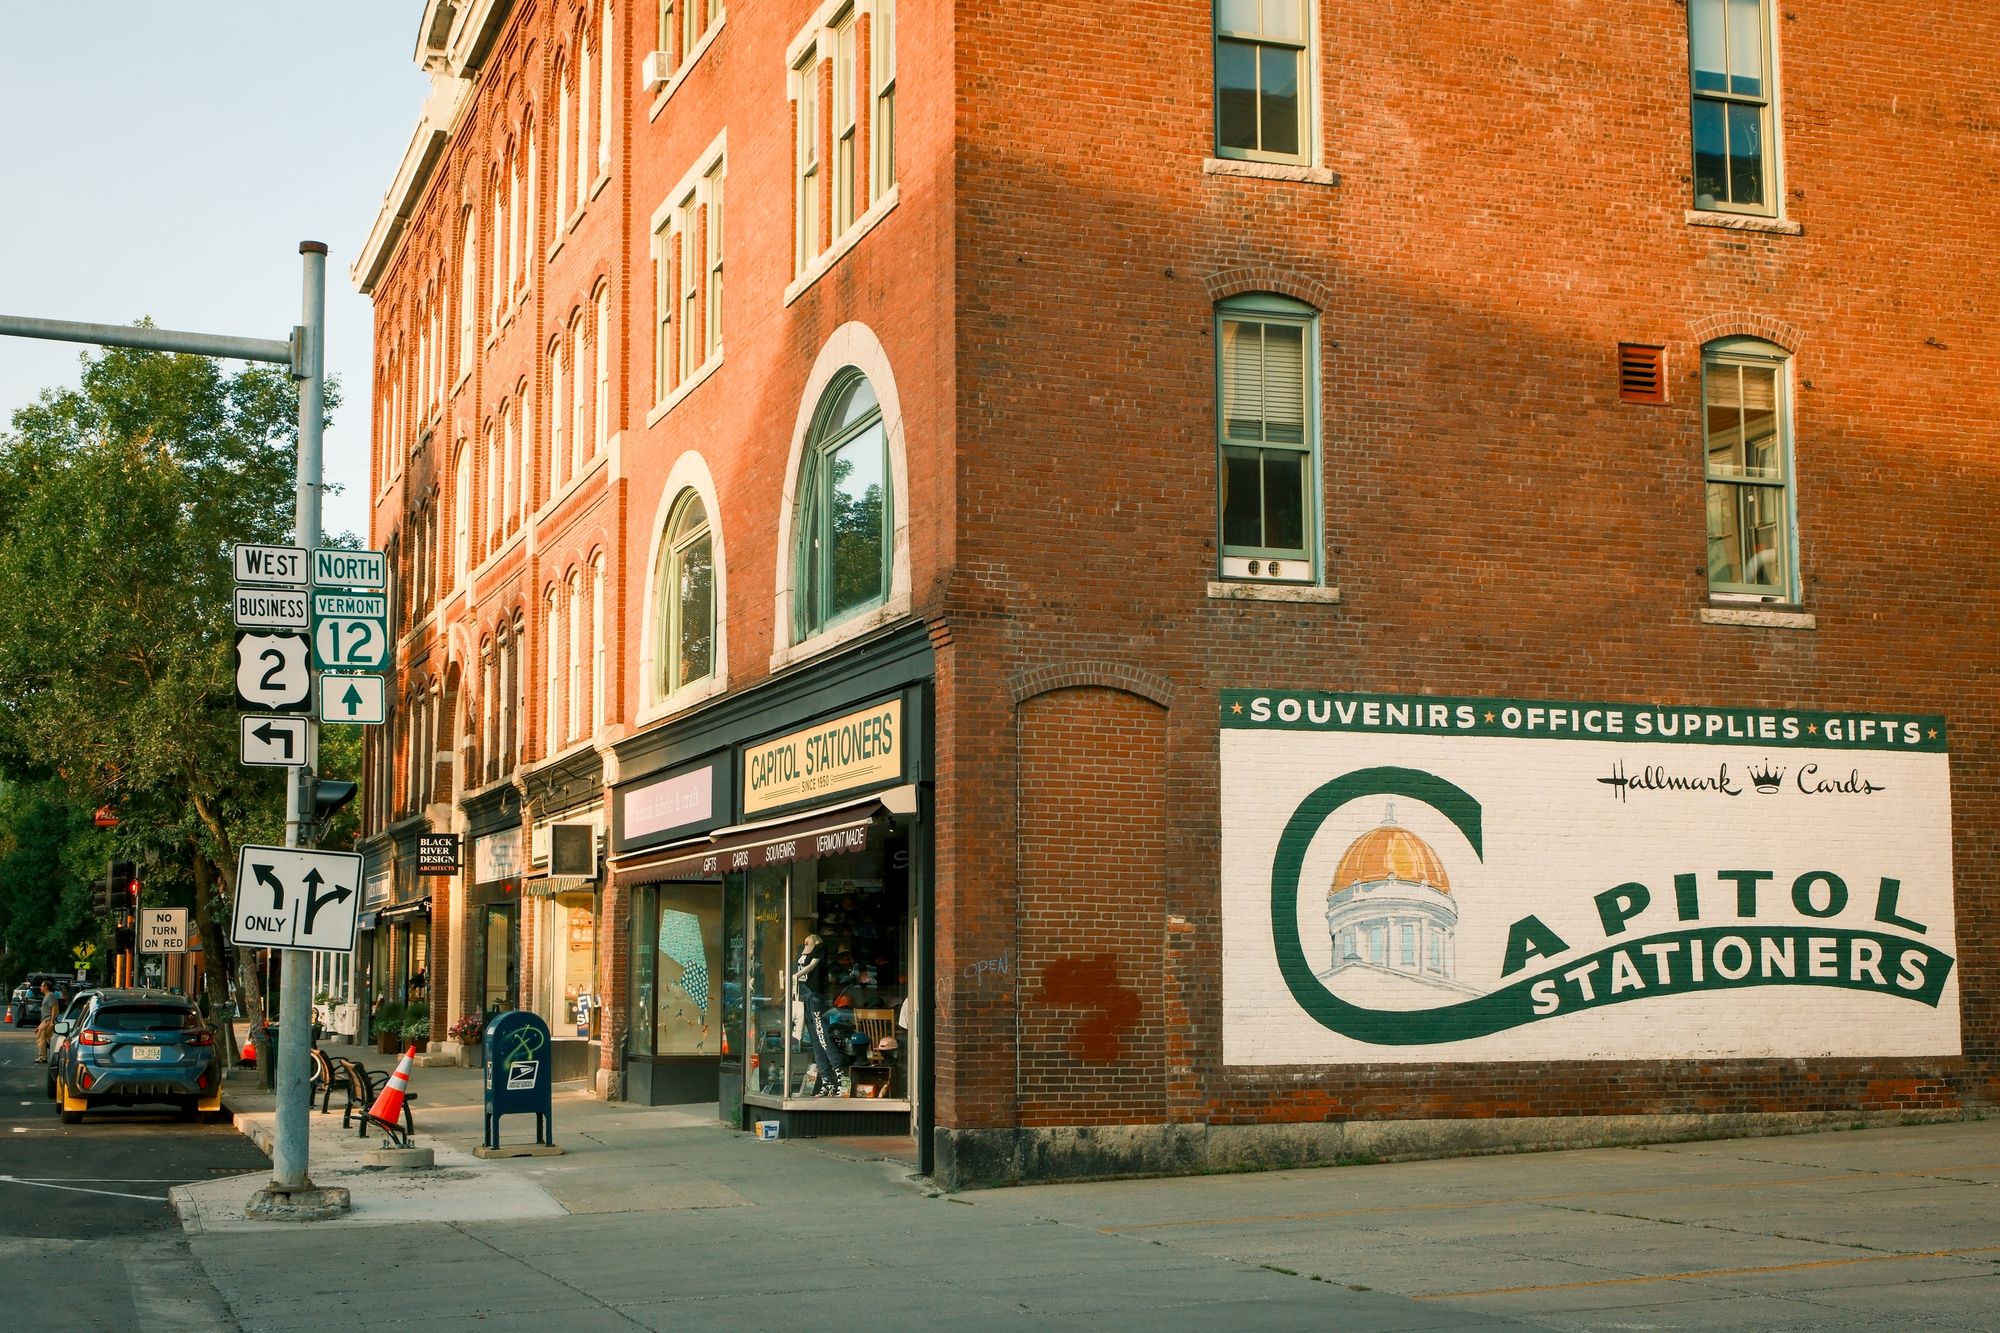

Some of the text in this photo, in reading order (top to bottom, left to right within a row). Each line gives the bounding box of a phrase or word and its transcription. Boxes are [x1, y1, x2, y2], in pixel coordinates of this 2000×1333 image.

[245, 549, 298, 576] WEST
[319, 553, 380, 580] NORTH
[240, 597, 304, 618] BUSINESS
[318, 597, 381, 614] VERMONT
[329, 621, 373, 663] 12
[259, 648, 287, 691] 2
[1250, 697, 1921, 744] SOUVENIRS OFFICE SUPPLIES GIFTS
[751, 712, 893, 791] CAPITOL STATIONERS
[801, 775, 830, 793] SINCE 1950
[1596, 758, 1886, 804] Hallmark Cards
[420, 838, 453, 846] BLACK
[420, 847, 449, 855] RIVER
[703, 827, 864, 871] GIFTS CARDS SOUVENIRS VERMONT MADE
[420, 855, 455, 863] DESIGN
[156, 913, 172, 922] NO
[245, 915, 287, 932] ONLY
[151, 926, 177, 935] TURN
[144, 938, 183, 948] ON RED
[963, 951, 1009, 986] OPEN
[1529, 935, 1929, 1015] STATIONERS
